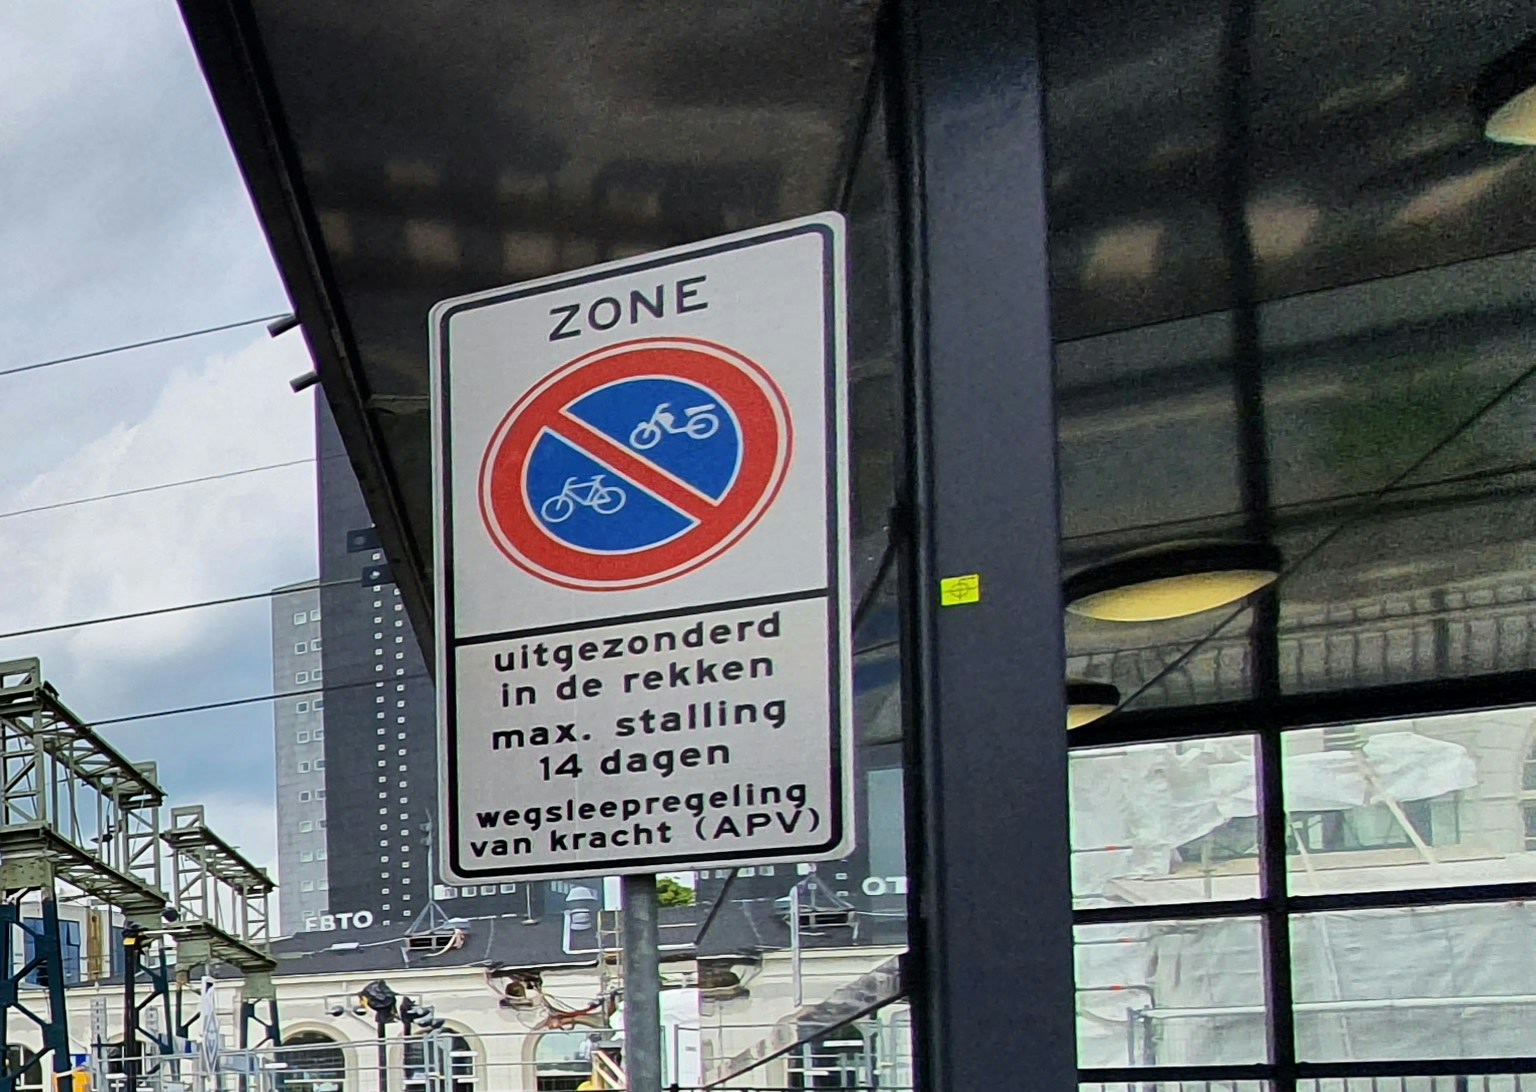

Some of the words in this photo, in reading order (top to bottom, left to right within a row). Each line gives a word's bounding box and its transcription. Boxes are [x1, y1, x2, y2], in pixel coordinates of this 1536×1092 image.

[548, 275, 709, 342] ZONE
[494, 610, 780, 672] uitgezonderd
[501, 682, 537, 708] in
[556, 674, 603, 701] de
[623, 656, 774, 693] rekken
[492, 722, 591, 750] max.
[616, 699, 787, 737] stalling
[539, 753, 583, 781] 14
[600, 743, 730, 778] dagen
[470, 835, 532, 857] van
[549, 821, 672, 852] kracht
[695, 807, 821, 841] (APV)
[476, 783, 807, 831] wegsleepregeling
